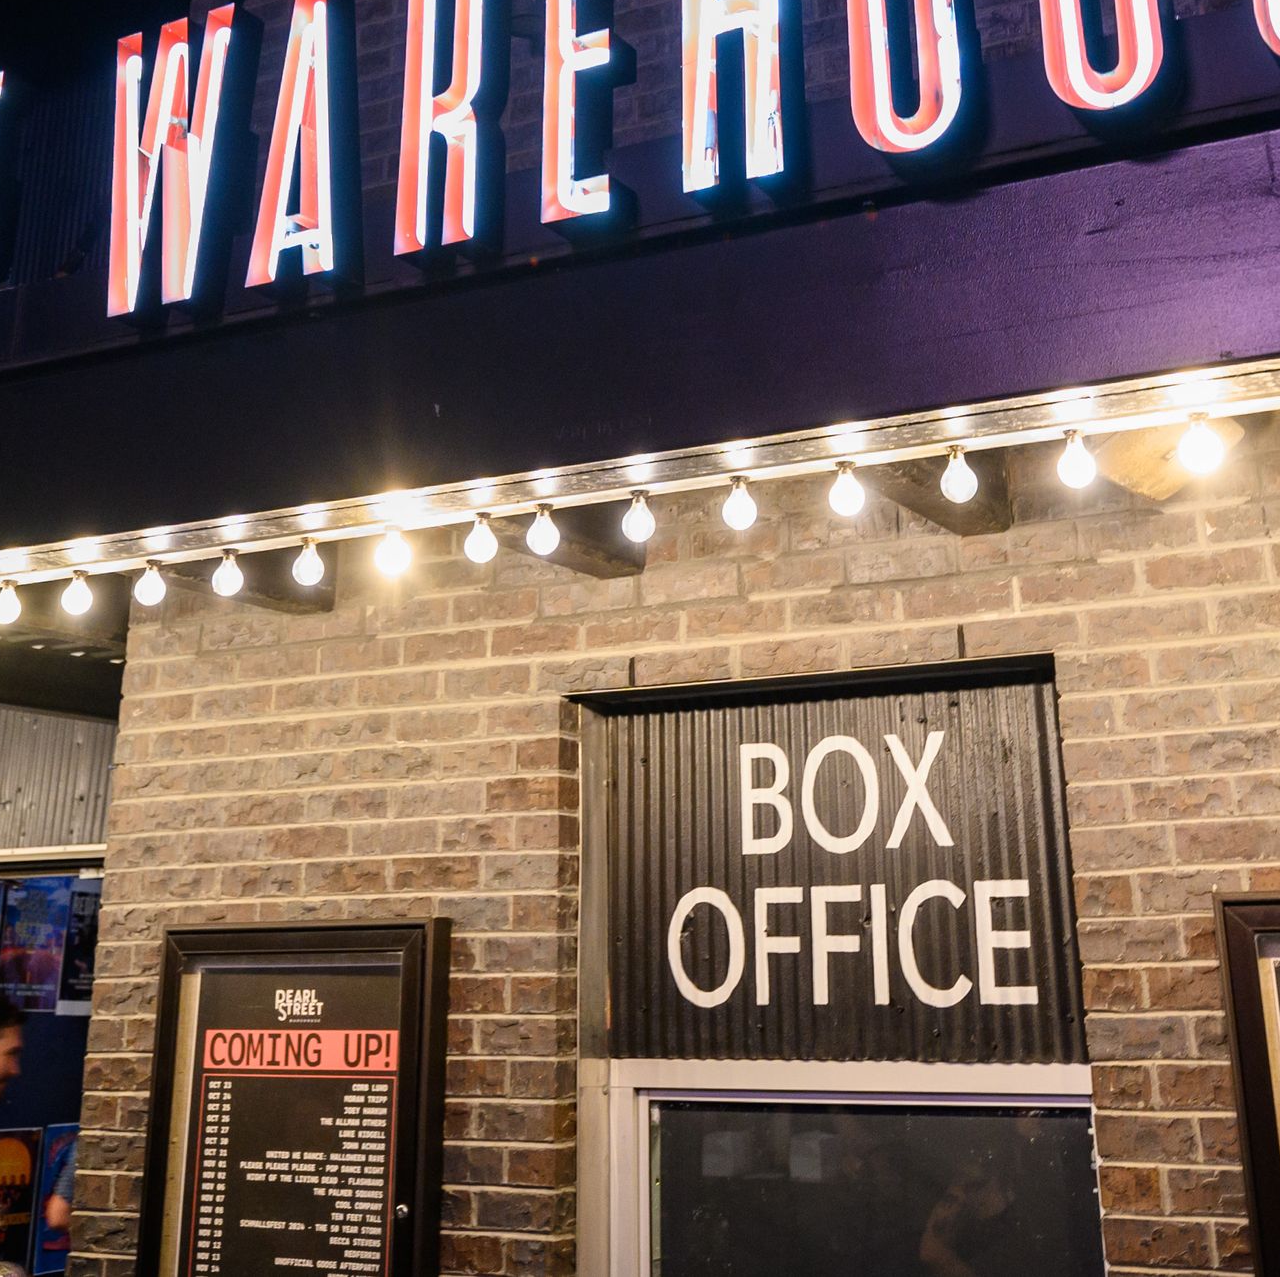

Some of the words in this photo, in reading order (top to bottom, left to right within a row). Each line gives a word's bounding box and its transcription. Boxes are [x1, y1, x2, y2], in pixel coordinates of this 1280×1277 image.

[740, 731, 955, 855] BOX
[668, 879, 1039, 1008] OFFICE
[275, 989, 318, 1009] PEARL
[278, 1002, 324, 1021] STREET
[209, 1032, 322, 1067] COMING
[343, 1033, 391, 1067] UP!
